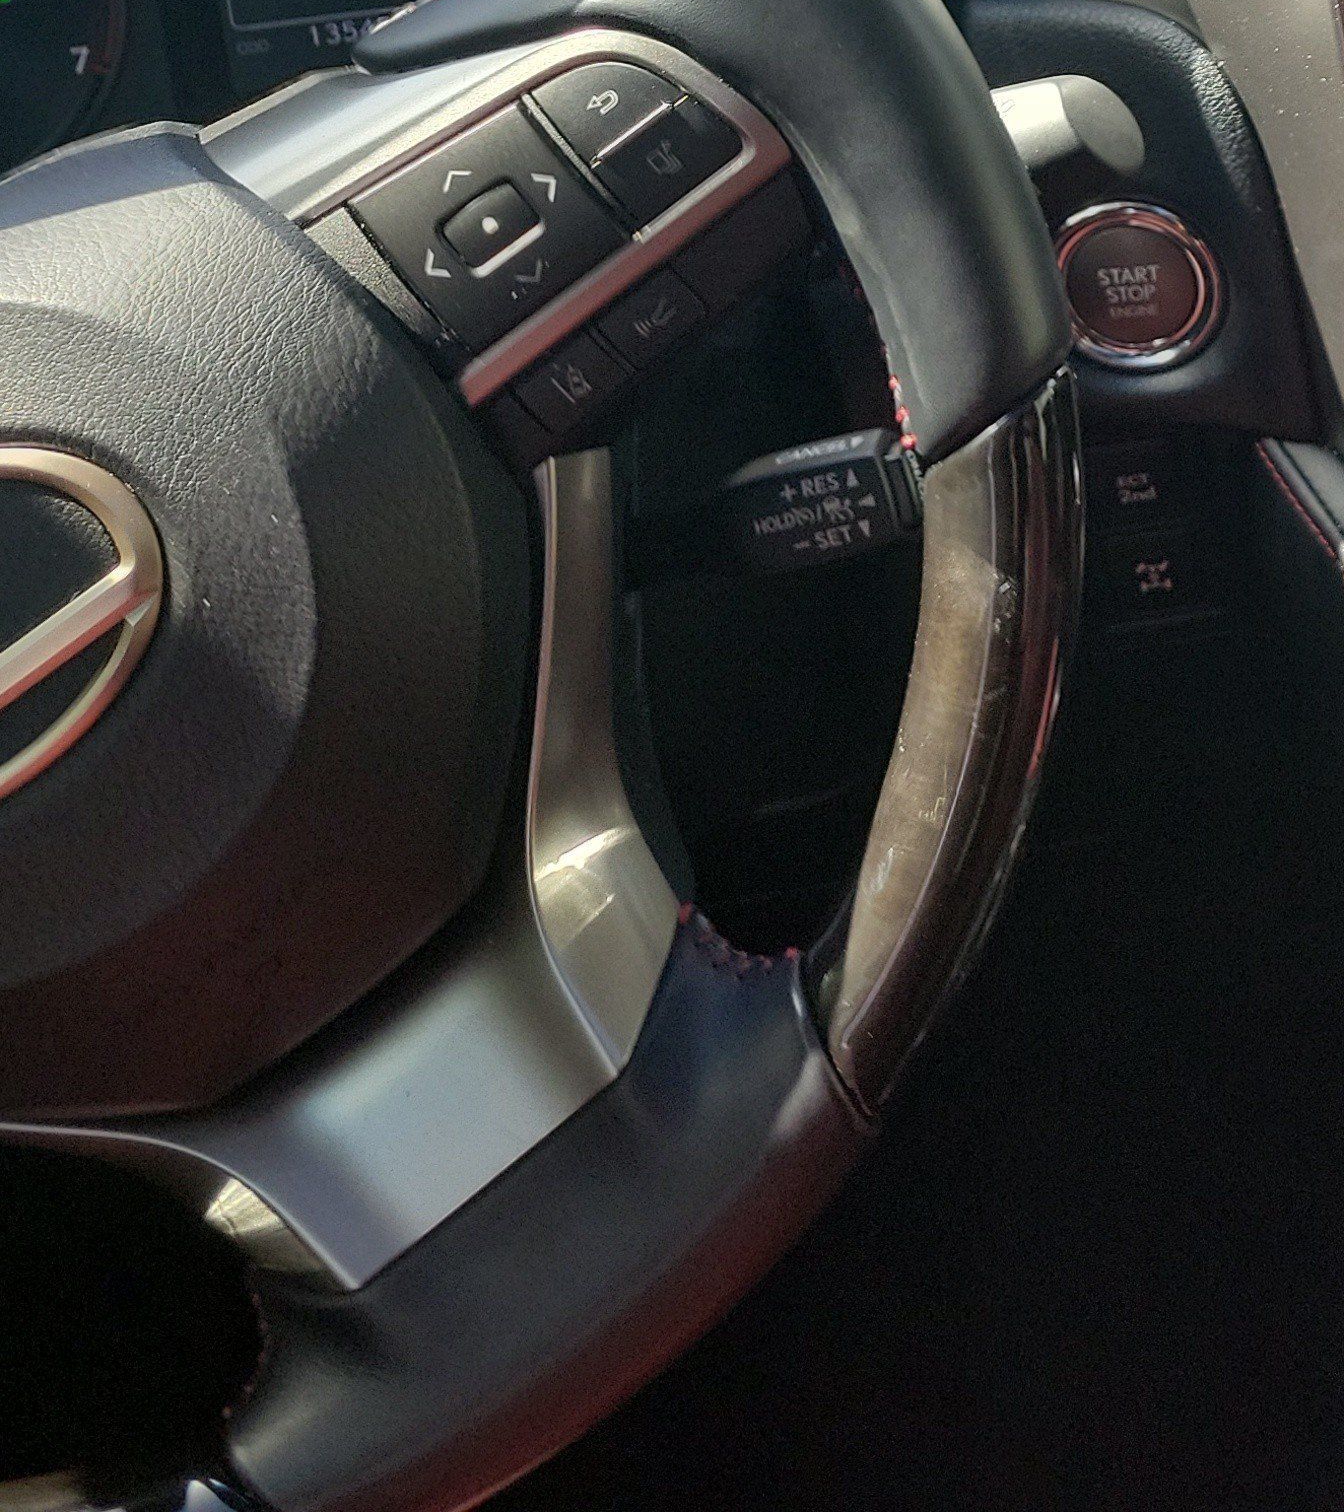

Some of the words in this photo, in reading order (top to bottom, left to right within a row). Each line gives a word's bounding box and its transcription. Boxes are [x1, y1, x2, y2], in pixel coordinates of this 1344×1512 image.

[69, 44, 91, 76] 7
[1097, 264, 1160, 287] START
[1106, 283, 1156, 304] STOP
